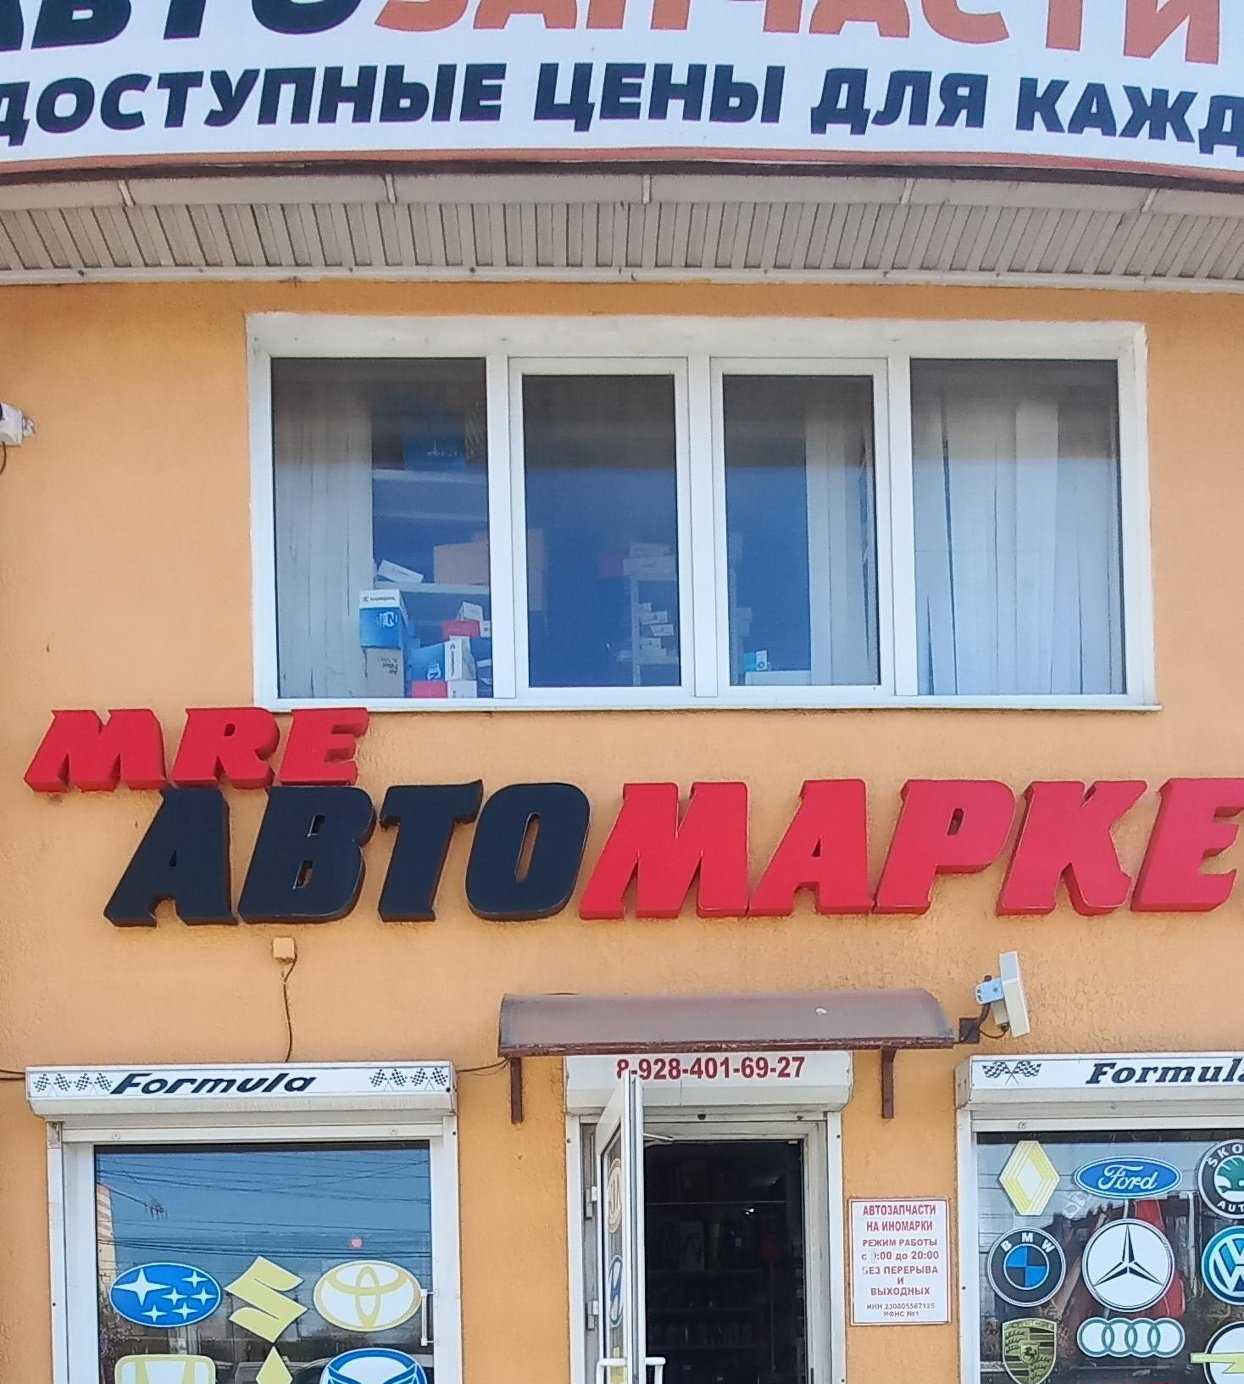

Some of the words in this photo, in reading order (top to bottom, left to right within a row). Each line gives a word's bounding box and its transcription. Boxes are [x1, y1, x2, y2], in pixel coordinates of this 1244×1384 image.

[533, 62, 786, 132] ЦЕНЫ
[810, 66, 989, 136] ДЛЯ
[1016, 76, 1244, 158] КАЖД
[23, 707, 370, 793] MRE
[111, 1072, 317, 1095] Formula
[1097, 1164, 1158, 1191] Ford
[862, 1204, 936, 1216] АВТОЗАПЧАСТИ
[866, 1221, 879, 1232] НА
[881, 1220, 933, 1232] ИНОМАРКИ
[862, 1239, 896, 1247] РЕЖИМ
[899, 1238, 938, 1247] РАБОТЫ
[1000, 1231, 1056, 1254] BMW
[871, 1251, 892, 1260] :00
[895, 1252, 908, 1262] до
[911, 1250, 939, 1260] 20:00
[883, 1265, 939, 1275] ПЕРЕРЫВА
[896, 1277, 904, 1285] И
[870, 1287, 931, 1297] ВЫХОДНЫХ
